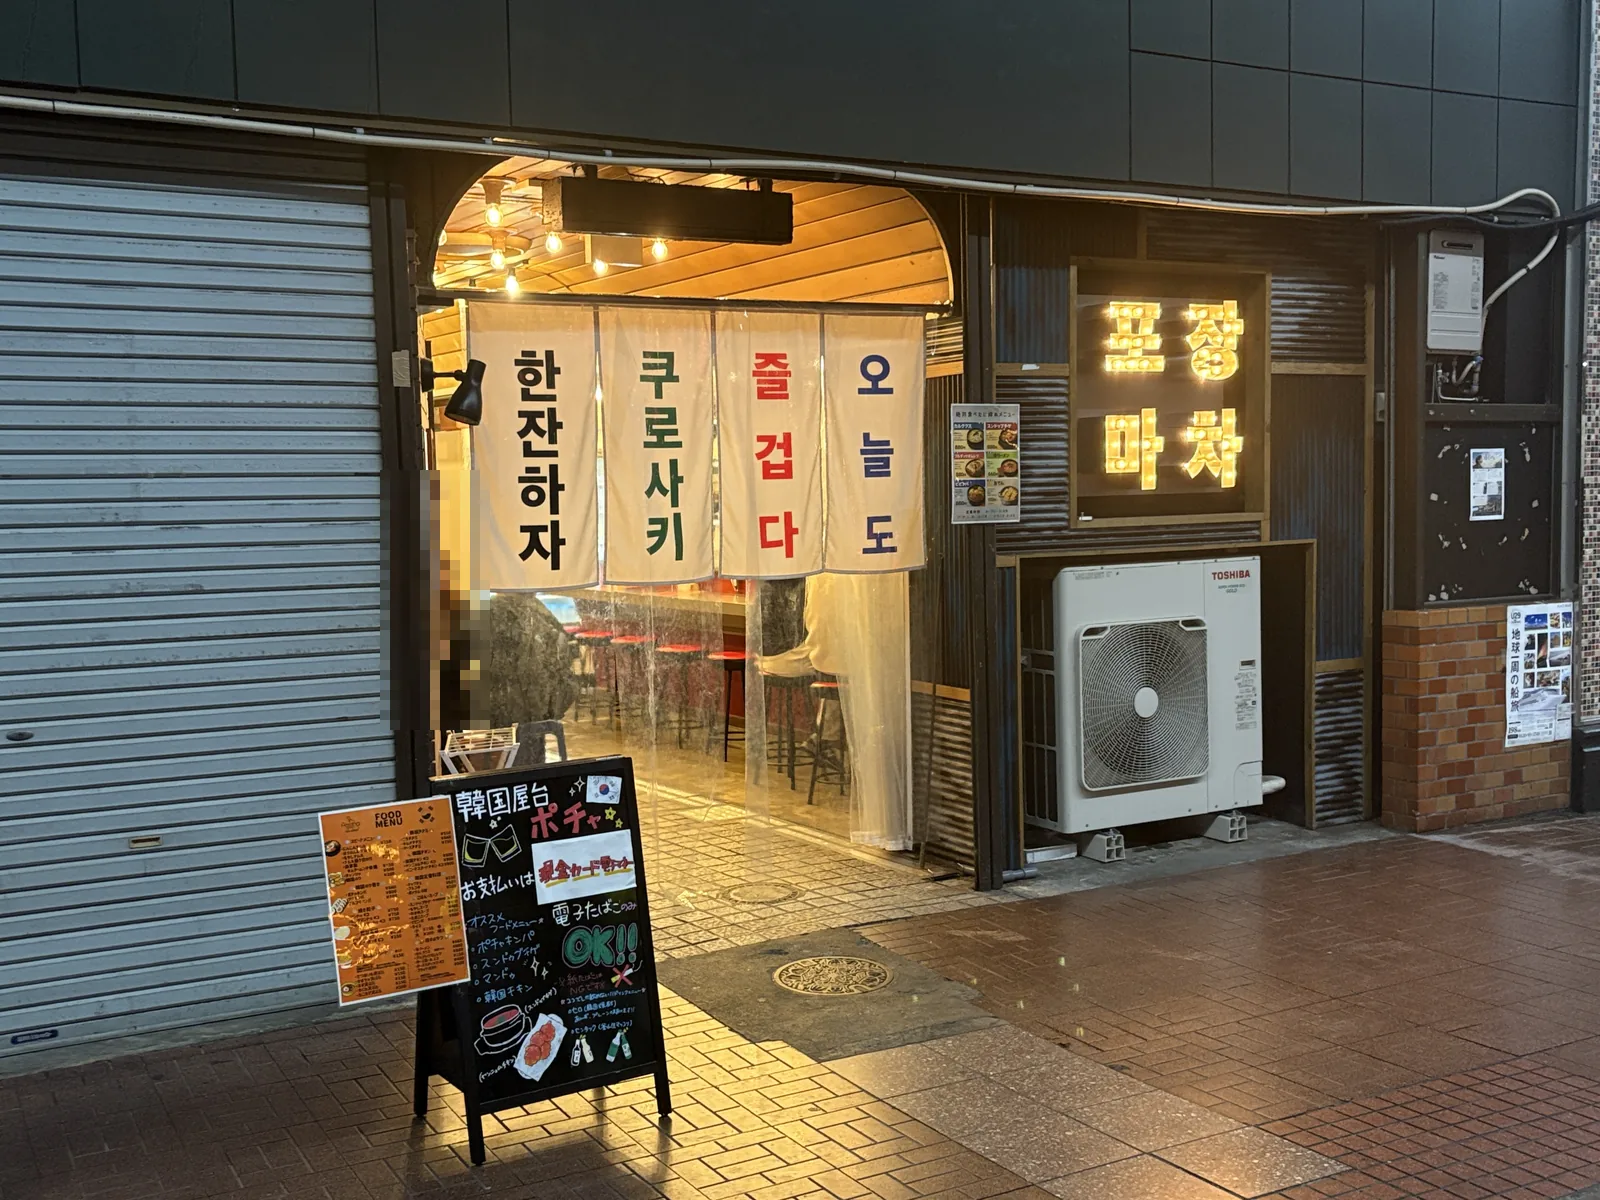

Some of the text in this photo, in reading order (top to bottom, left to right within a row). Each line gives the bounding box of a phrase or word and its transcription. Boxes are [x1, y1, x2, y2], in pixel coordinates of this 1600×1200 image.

[513, 349, 567, 571] 한잔하자
[639, 350, 684, 562] 쿠로사키
[751, 352, 799, 559] 즐겁다
[857, 354, 898, 555] 오늘도
[1211, 569, 1251, 581] TOSHIBA
[1510, 628, 1522, 713] 地球一周の船旅
[375, 810, 402, 821] FOOD
[456, 782, 549, 823] 韓国屋台
[375, 818, 403, 829] MENU
[530, 802, 602, 839] ポチャ
[461, 871, 535, 901] お支払いは
[467, 912, 505, 928] オススメ
[490, 919, 537, 933] フードメニュー
[552, 898, 637, 927] 電子たばこのみ
[477, 930, 535, 954] ポチャキンパ
[561, 922, 638, 969] OK!!
[483, 967, 515, 984] マンドゥ
[484, 984, 533, 1003] 韓国チキン
